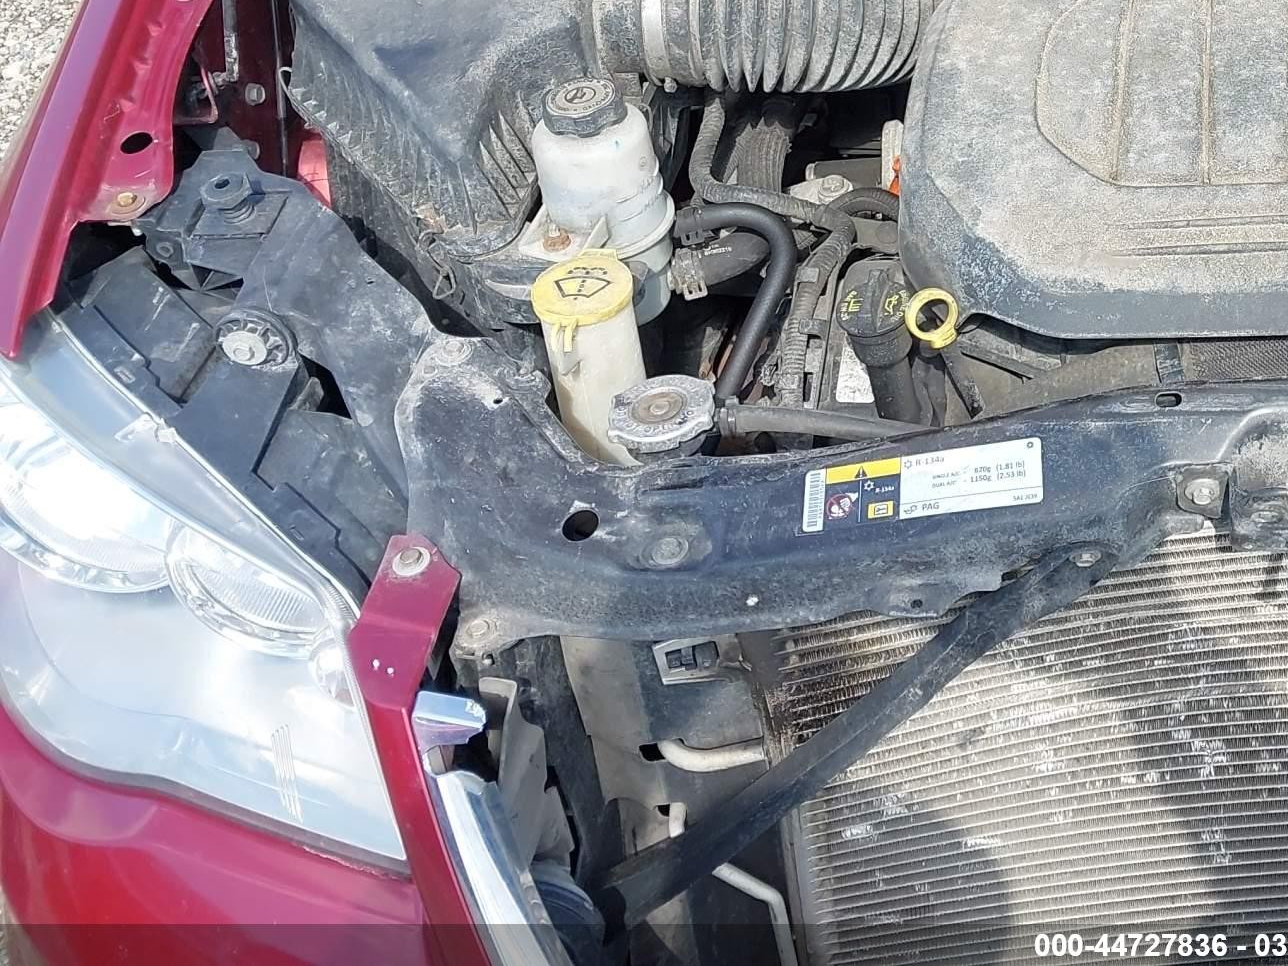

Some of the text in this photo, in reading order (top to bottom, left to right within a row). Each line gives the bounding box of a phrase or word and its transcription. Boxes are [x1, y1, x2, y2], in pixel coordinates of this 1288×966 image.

[914, 455, 945, 467] R-134a
[996, 462, 1014, 472] (1.81
[1015, 460, 1026, 470] lb)
[970, 474, 992, 483] 1150g
[997, 472, 1015, 481] (2.53
[1016, 469, 1027, 478] lb)
[922, 501, 940, 512] PAG
